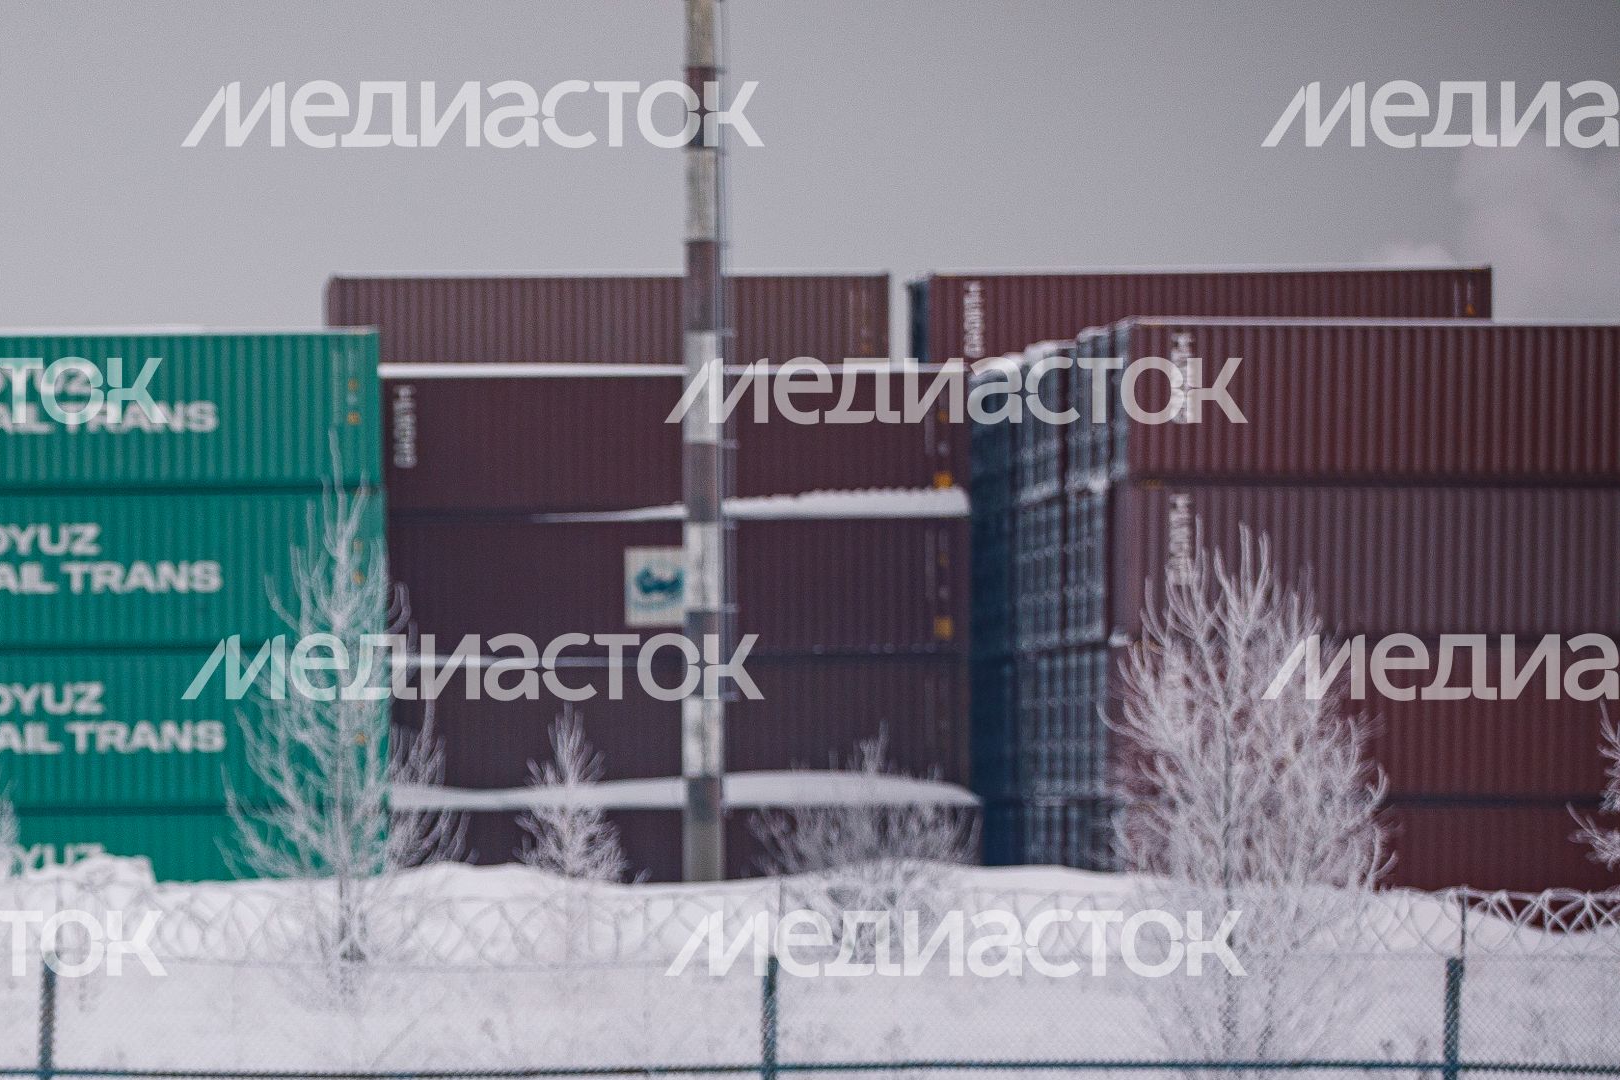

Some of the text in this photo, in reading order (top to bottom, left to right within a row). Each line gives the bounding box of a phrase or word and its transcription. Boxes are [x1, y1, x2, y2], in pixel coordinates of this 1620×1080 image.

[59, 401, 219, 434] TRANS
[61, 560, 223, 593] TRANS
[65, 719, 226, 753] TRANS
